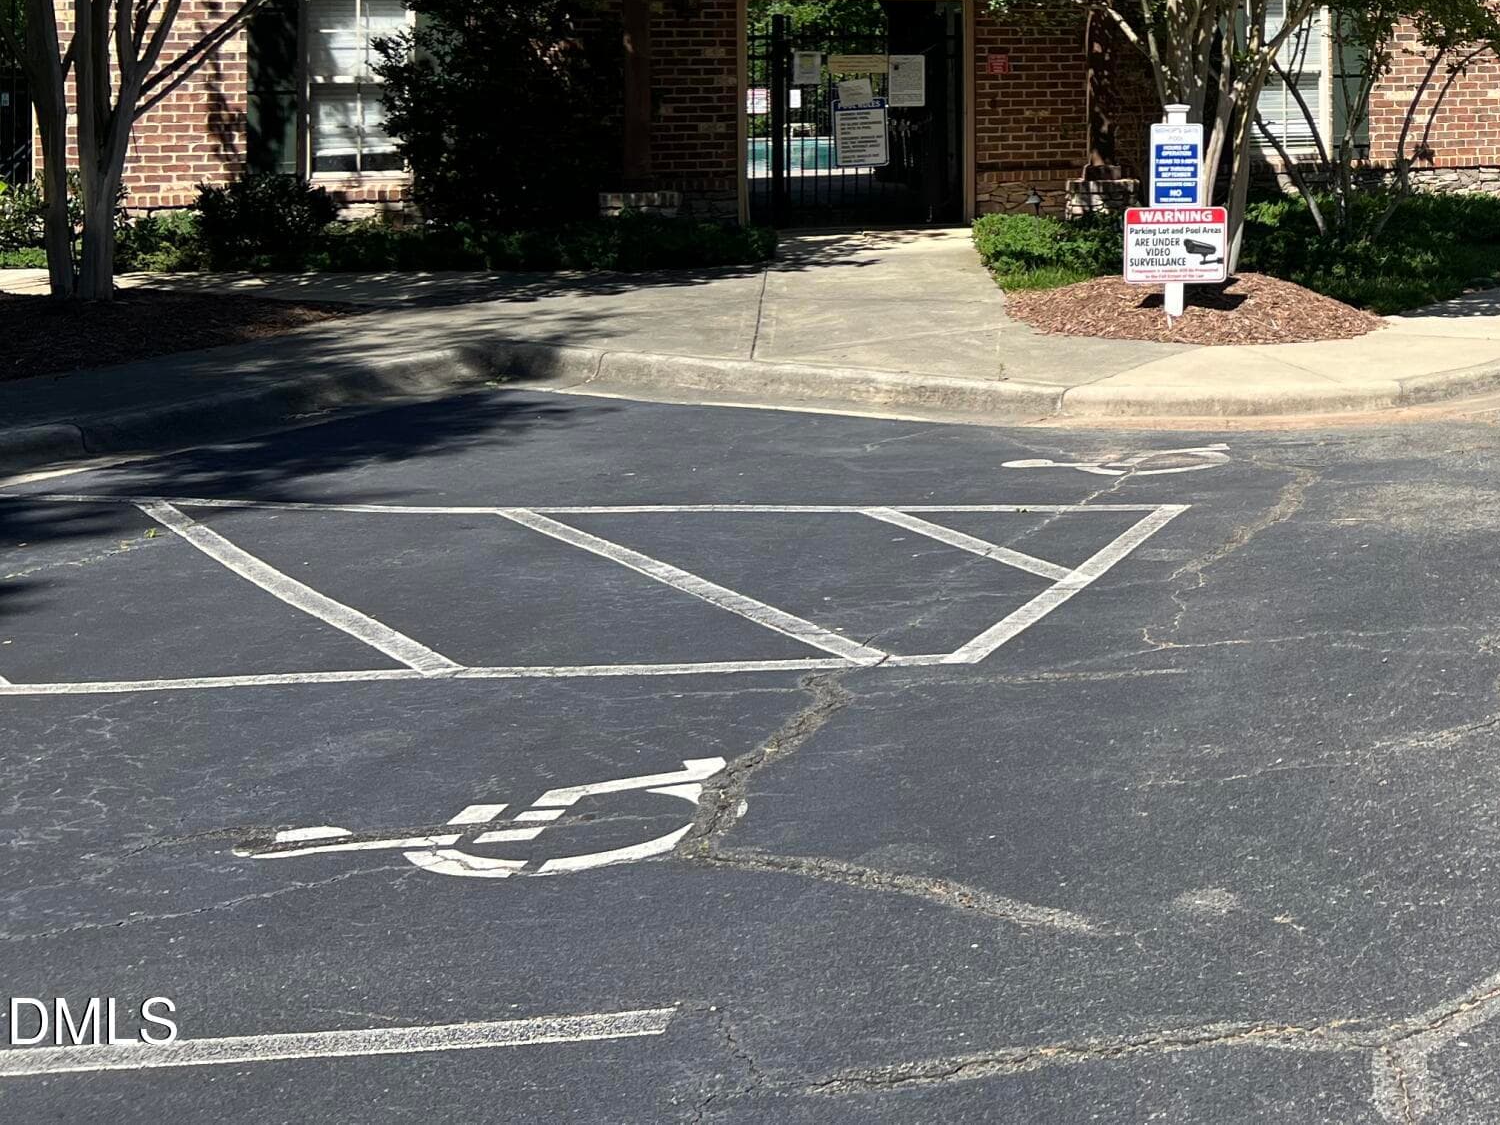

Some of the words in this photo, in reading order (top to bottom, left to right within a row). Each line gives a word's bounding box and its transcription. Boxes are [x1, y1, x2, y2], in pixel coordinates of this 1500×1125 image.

[1169, 189, 1183, 197] NO
[1138, 210, 1213, 223] WARNING
[1129, 227, 1156, 236] Parking
[1134, 238, 1151, 246] ARE
[1152, 237, 1181, 246] UNDER
[1145, 248, 1171, 257] VIDEO
[1129, 257, 1187, 267] SURVEILLANCE
